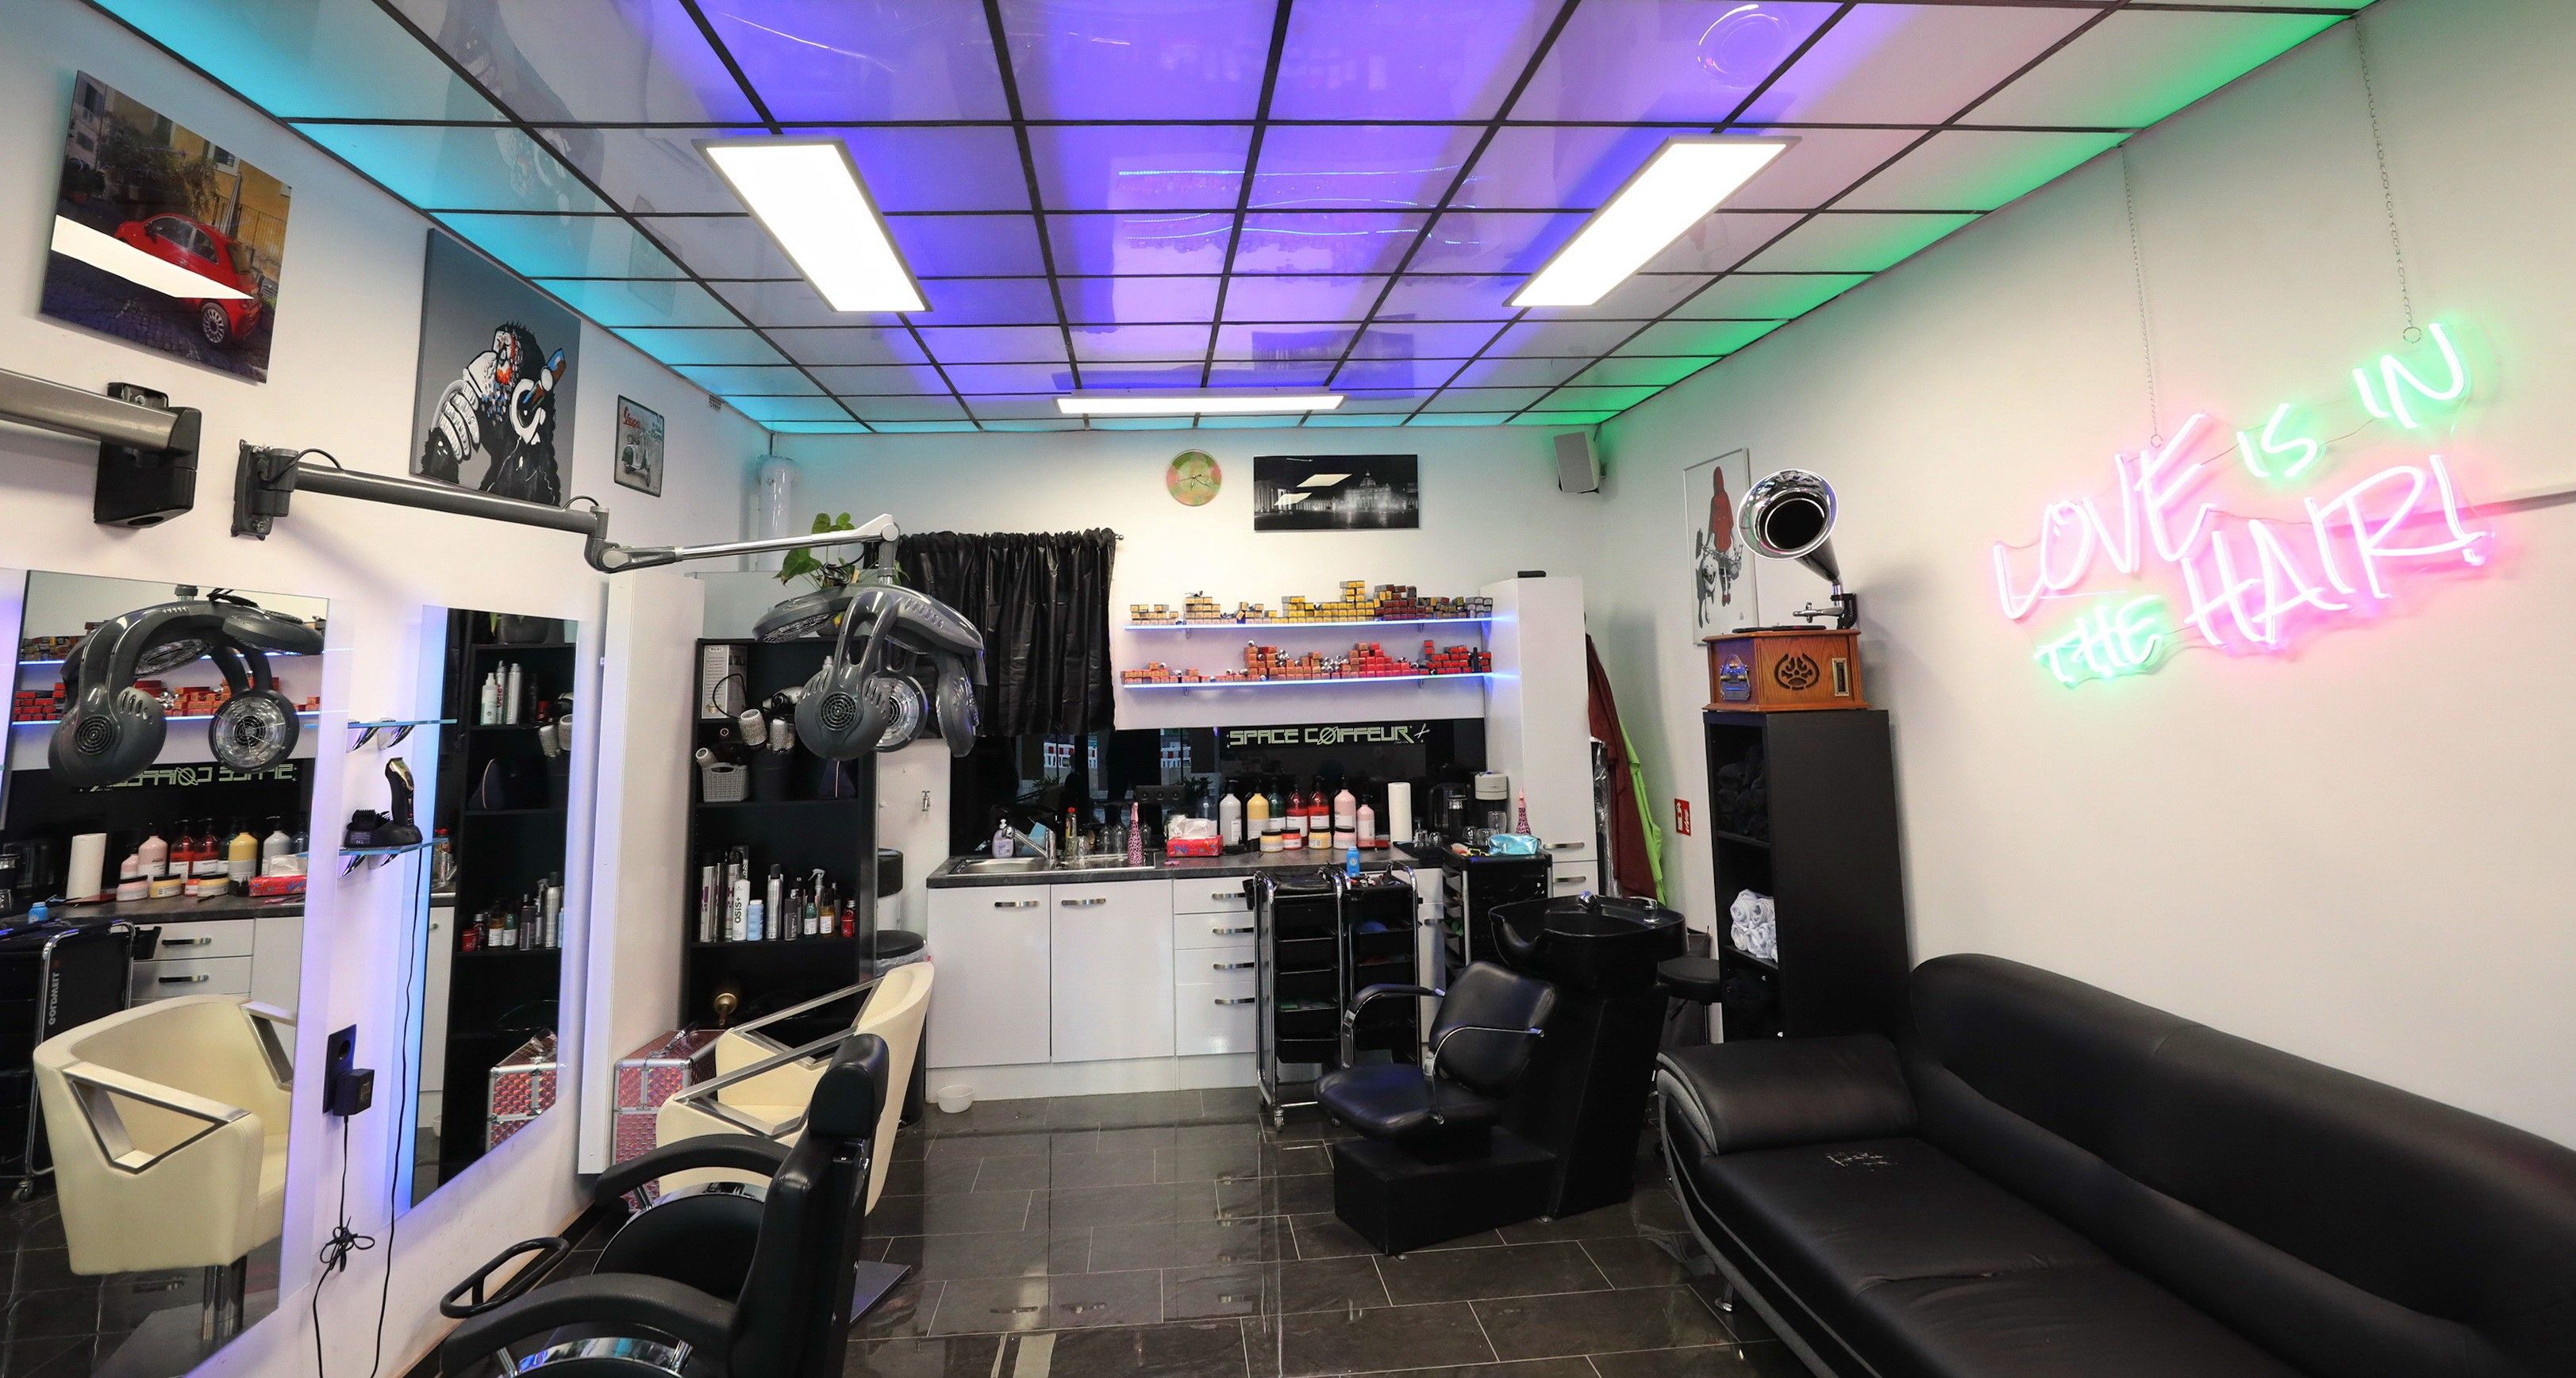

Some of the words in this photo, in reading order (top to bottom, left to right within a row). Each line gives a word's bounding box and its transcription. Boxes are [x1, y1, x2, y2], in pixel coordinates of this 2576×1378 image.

[1993, 413, 2217, 619] LOVE
[2237, 403, 2318, 477] IS
[2352, 323, 2465, 429] IN
[2033, 594, 2164, 684] THE
[2181, 454, 2490, 646] HAIR!
[1229, 728, 1299, 746] SPACE
